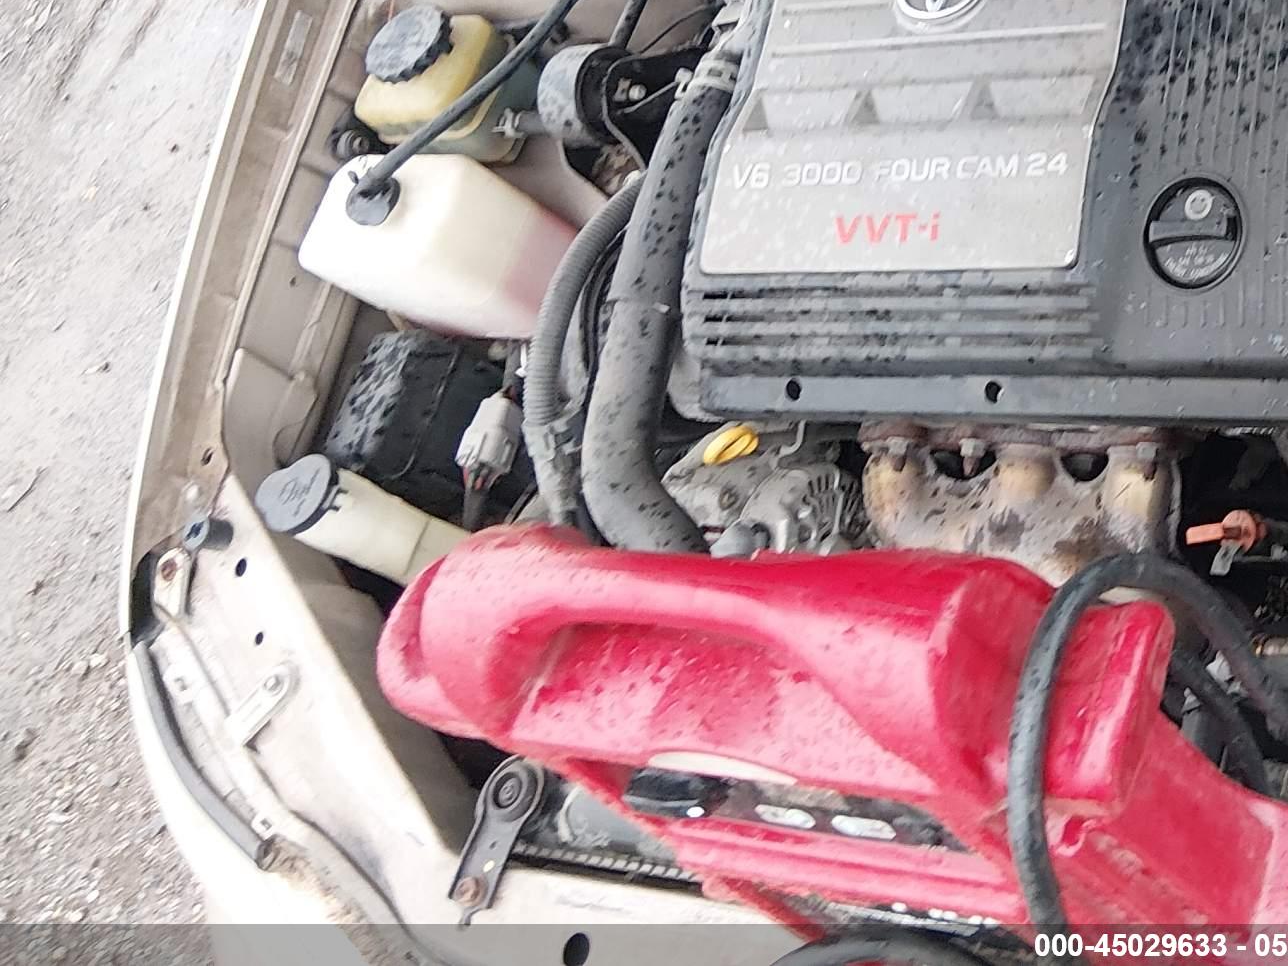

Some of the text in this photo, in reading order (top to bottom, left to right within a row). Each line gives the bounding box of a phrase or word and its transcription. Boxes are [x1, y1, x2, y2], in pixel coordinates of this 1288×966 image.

[733, 151, 1069, 190] V6 3000 FOUR CAM 24
[835, 210, 942, 245] VVT-i
